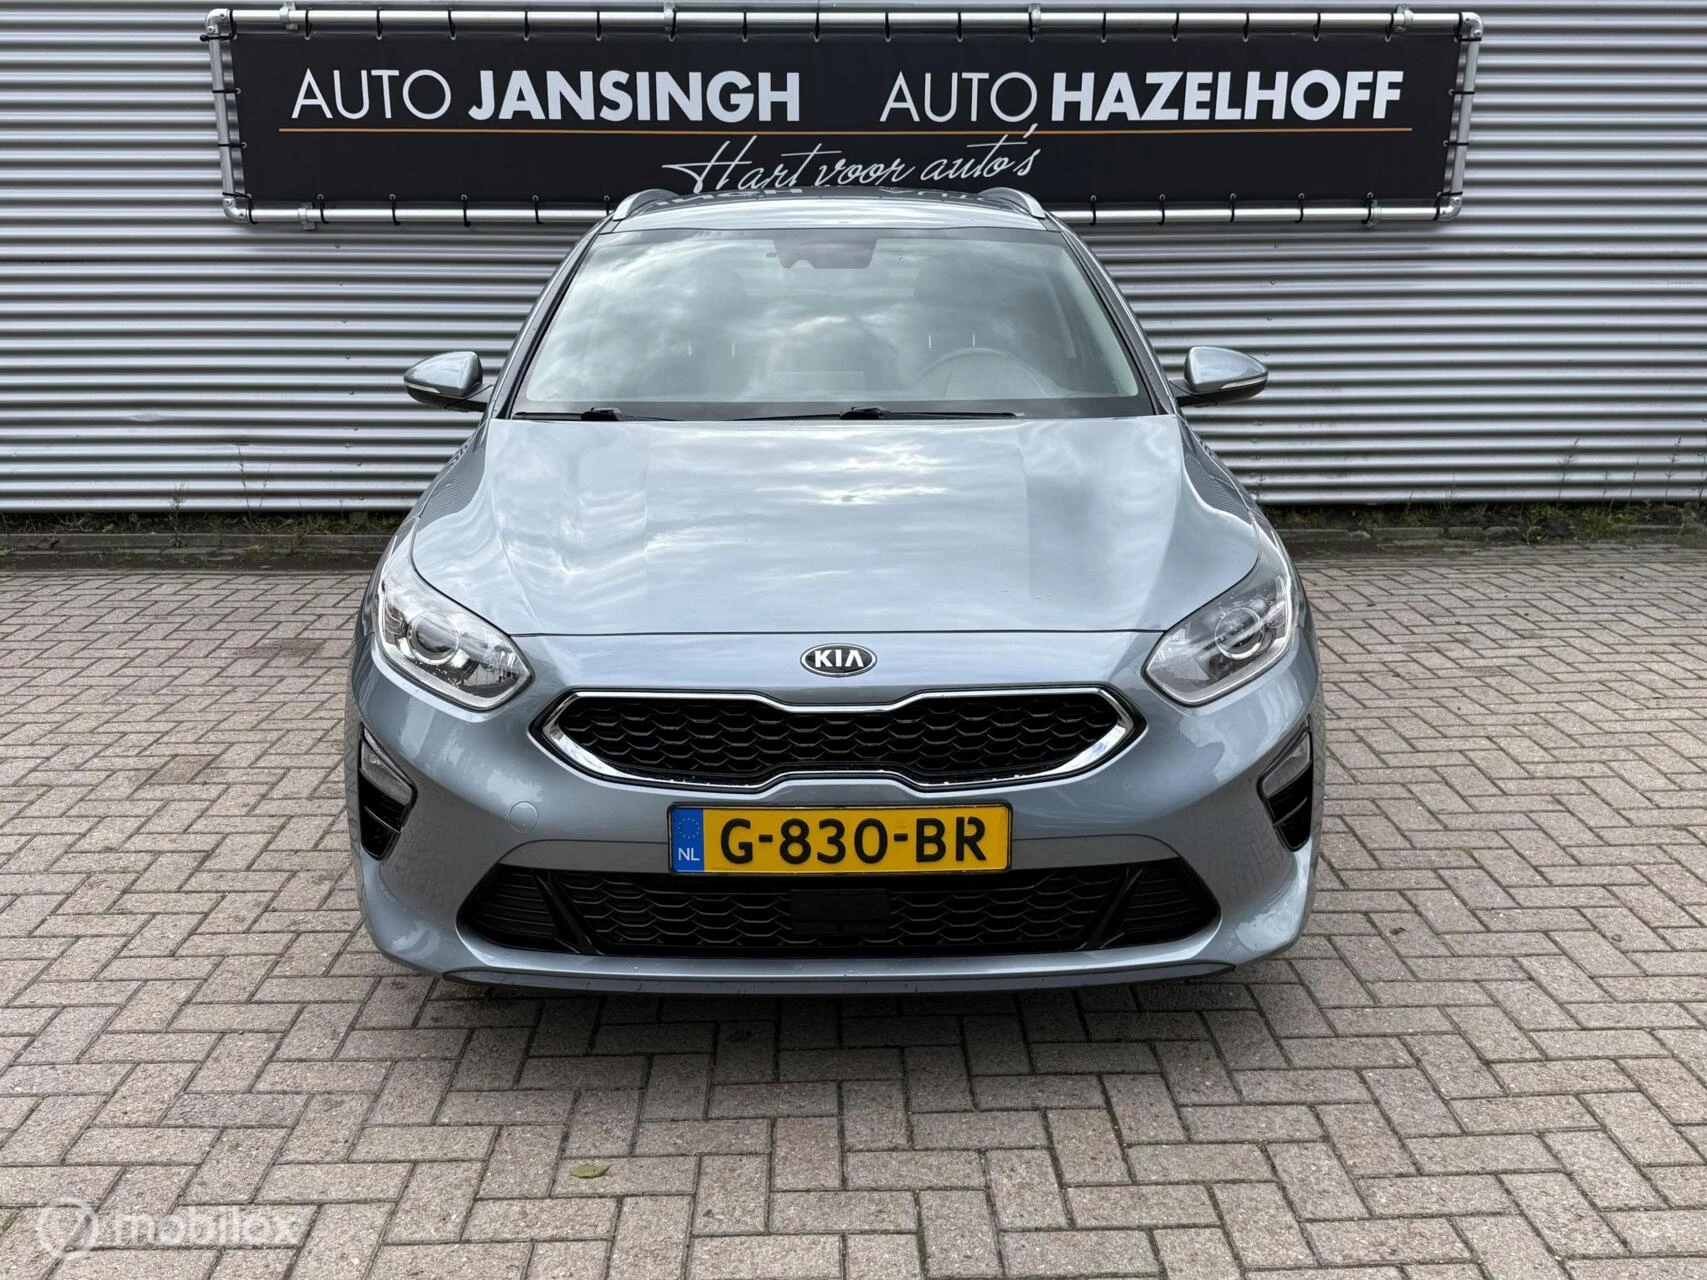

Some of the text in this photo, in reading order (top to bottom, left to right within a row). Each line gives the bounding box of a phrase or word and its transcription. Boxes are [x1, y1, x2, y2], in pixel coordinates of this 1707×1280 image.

[291, 68, 801, 123] AUTO JANSINGH
[880, 70, 1404, 123] AUTO HAZELHOFF
[662, 123, 1041, 194] Hart voor auto's
[814, 649, 864, 668] KIA
[678, 847, 700, 862] NL
[720, 816, 988, 865] G-830-BR
